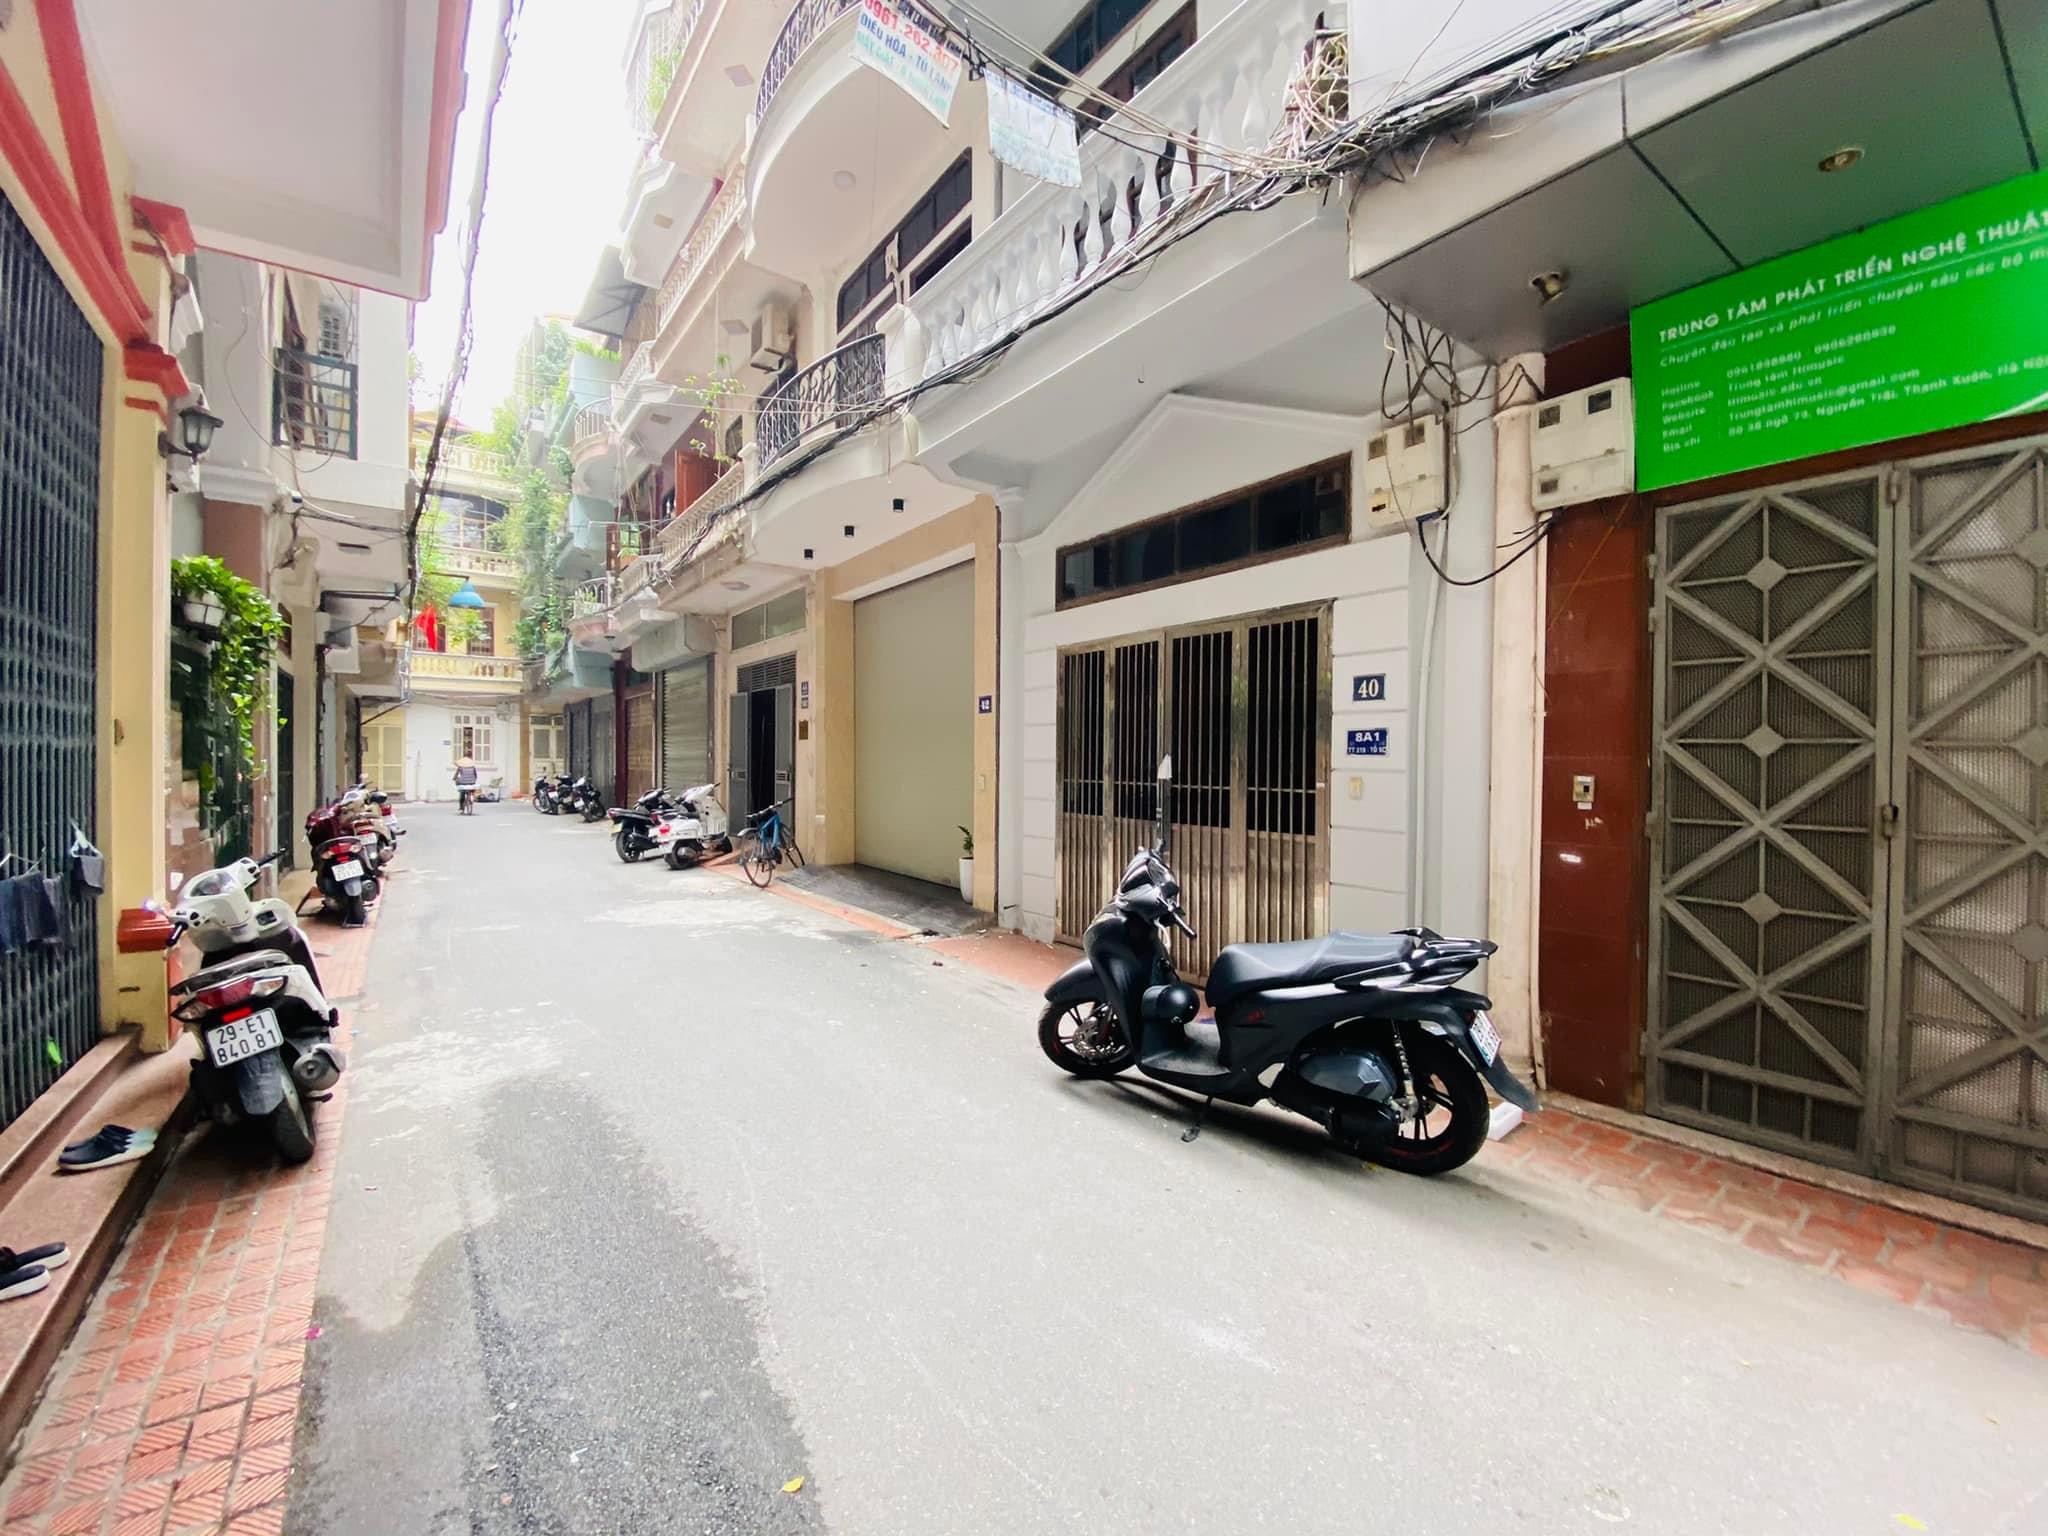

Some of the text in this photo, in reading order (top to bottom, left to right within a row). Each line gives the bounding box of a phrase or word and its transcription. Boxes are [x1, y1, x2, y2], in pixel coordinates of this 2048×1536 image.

[1659, 313, 1720, 344] TRUNG
[1727, 296, 1768, 321] TÂM
[1775, 277, 1828, 305] PHÁT
[1834, 254, 1893, 287] TRIỂN
[1901, 232, 1967, 267] NGHỆ
[1358, 678, 1380, 699] 40
[1355, 731, 1380, 743] 8A1
[216, 1029, 278, 1064] 840.81
